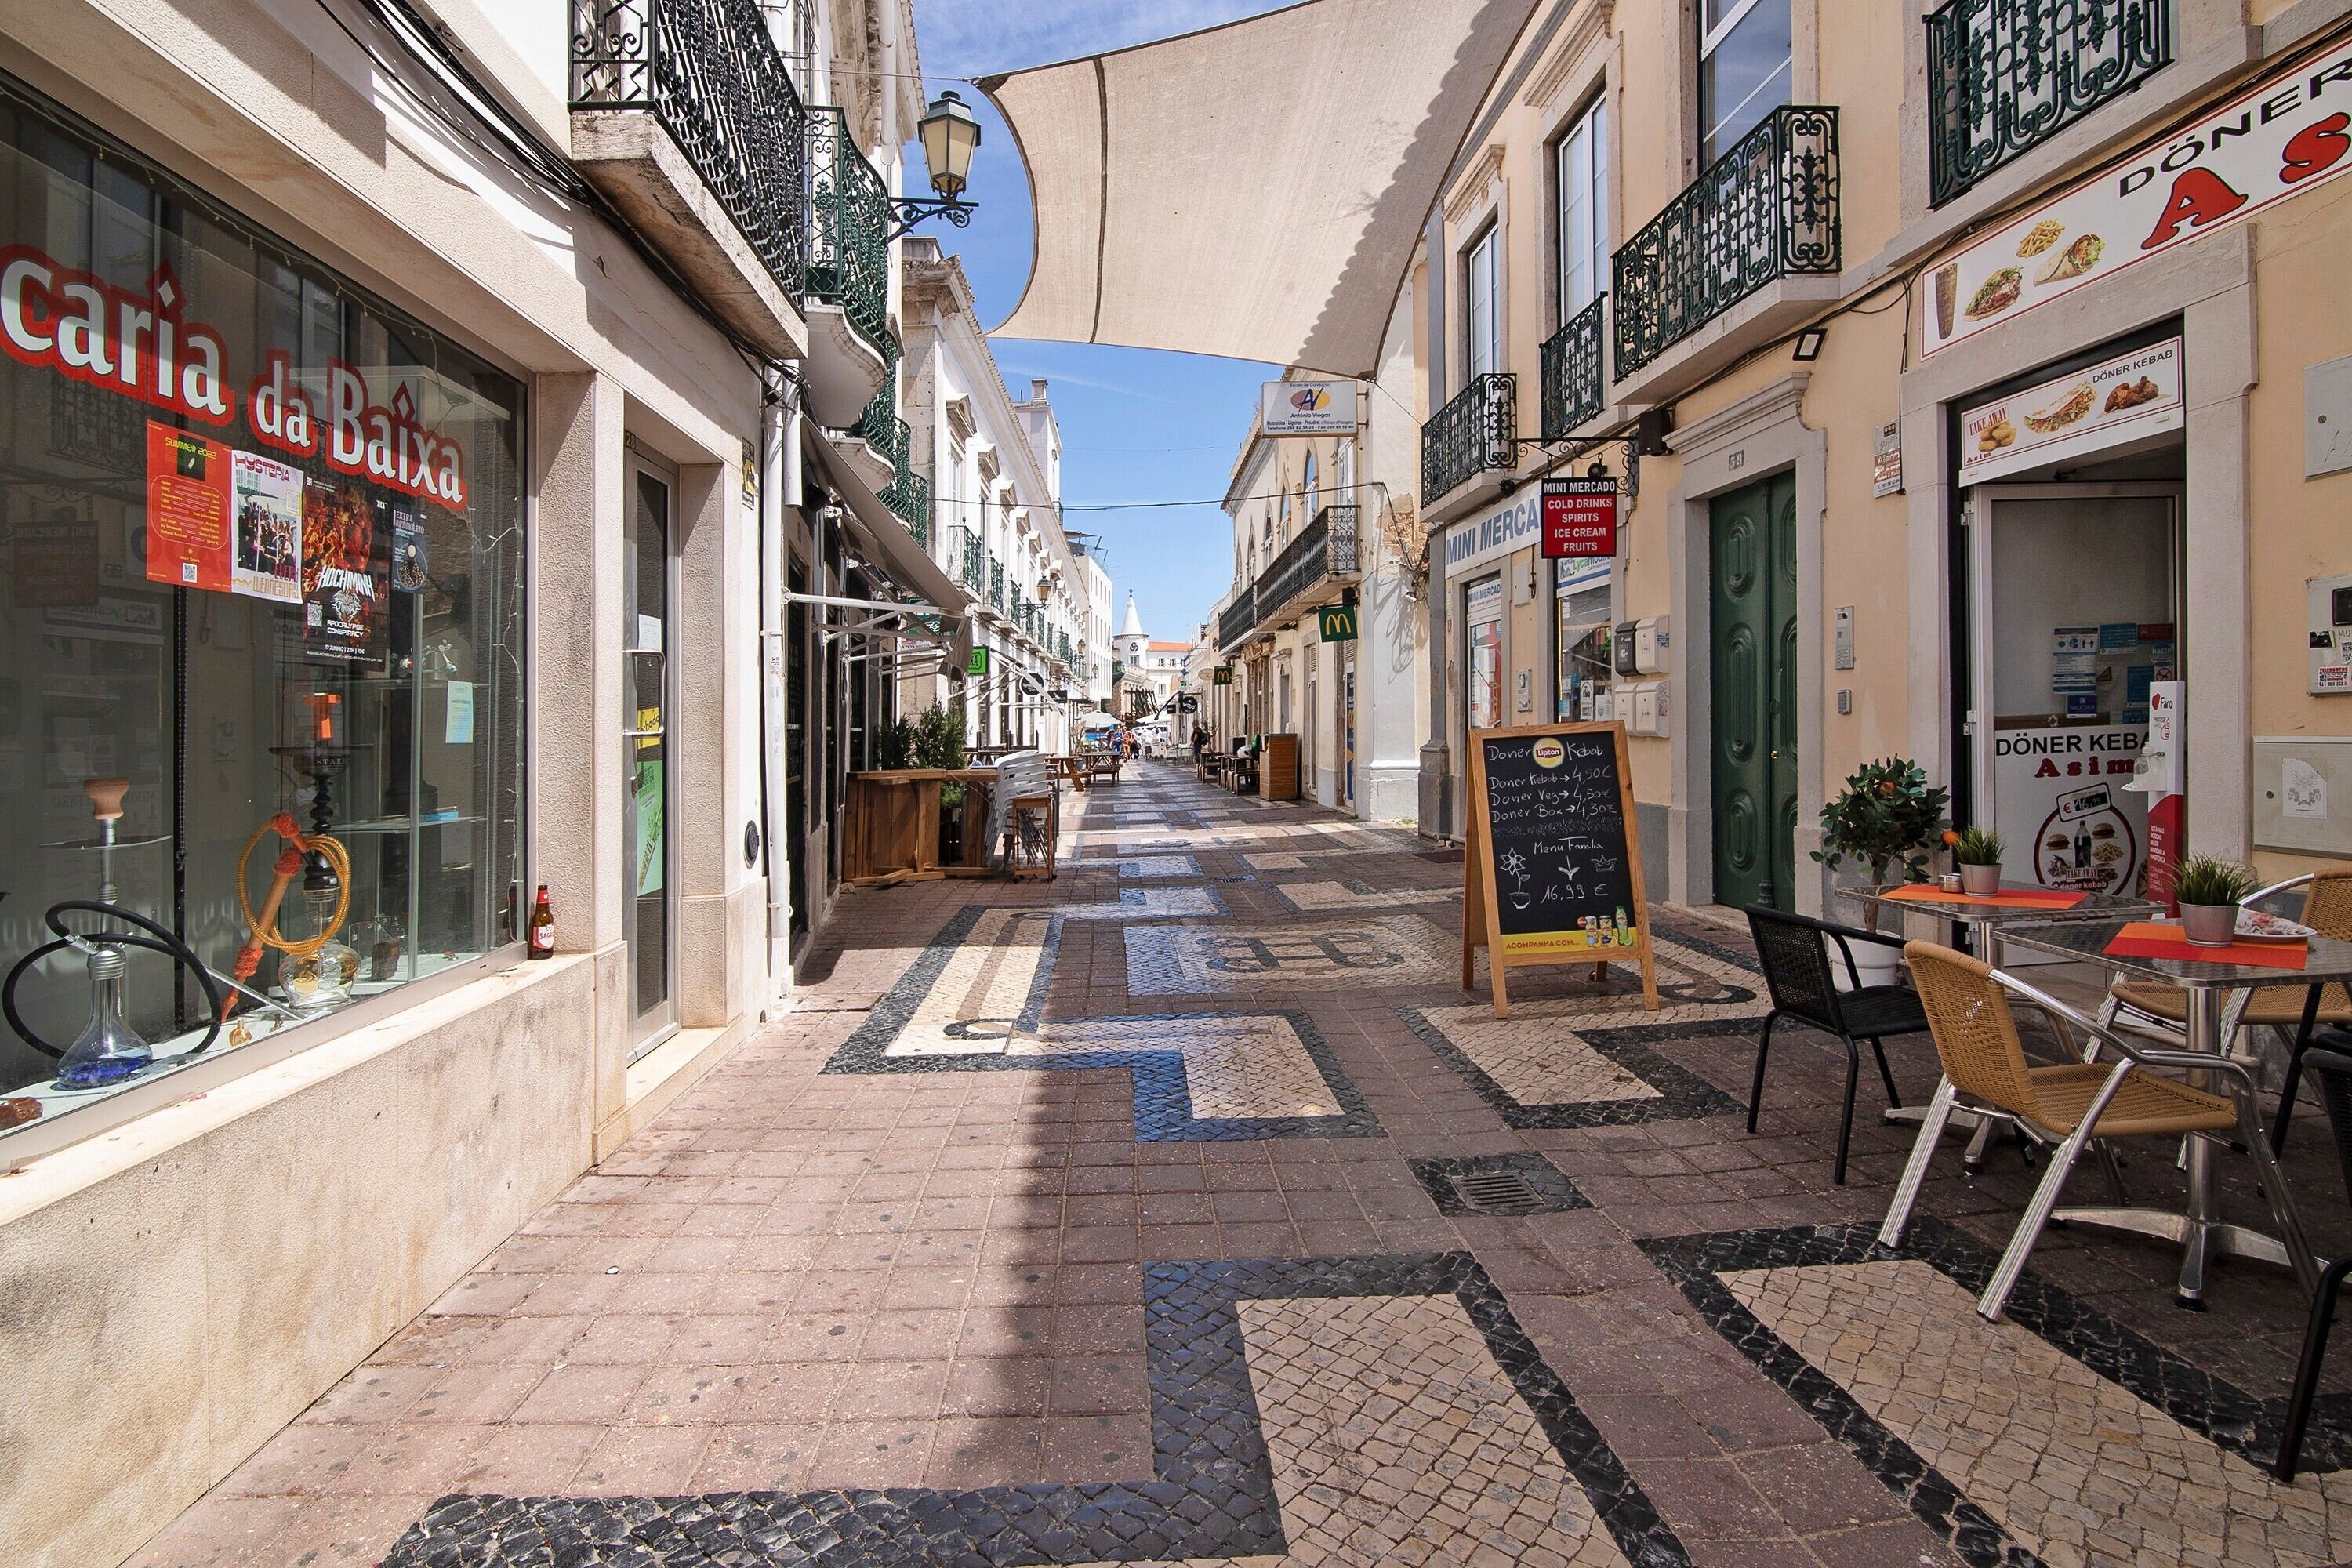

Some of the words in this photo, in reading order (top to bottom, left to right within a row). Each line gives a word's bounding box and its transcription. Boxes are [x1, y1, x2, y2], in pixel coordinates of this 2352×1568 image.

[2119, 60, 2352, 198] DÖNER
[2092, 365, 2130, 384] DÖNER
[2133, 349, 2173, 371] KEBAB
[0, 260, 227, 416] caria
[255, 361, 311, 448] da
[331, 366, 463, 503] Baixa
[1969, 416, 1987, 436] TAKE
[1988, 406, 2008, 427] AWAY
[165, 437, 196, 453] SUMMER
[198, 447, 217, 459] 2022
[234, 454, 290, 483] HYSTERIA
[1544, 483, 1567, 493] MINI
[1570, 481, 1615, 492] MERCADO
[1548, 500, 1573, 509] COLD
[1577, 499, 1612, 508] DRINKS
[397, 510, 413, 522] EXTRA
[1562, 513, 1599, 522] SPIRITS
[1446, 527, 1475, 565] MINI
[1480, 495, 1541, 551] MERCA
[1555, 529, 1570, 538] ICE
[1573, 528, 1606, 537] CREAM
[1563, 542, 1597, 551] FRUITS
[315, 565, 376, 602] HOCHIMINH
[1468, 591, 1479, 602] MINI
[327, 620, 364, 630] APOCALYPSE
[327, 627, 364, 637] CONSPIRACY
[2161, 696, 2173, 710] Faro
[1996, 733, 2082, 756] DÖNER
[1487, 746, 1532, 760] Doner
[2034, 756, 2135, 778] Asim
[1488, 776, 1526, 789] Doner
[1490, 793, 1532, 806] Doner
[1538, 789, 1559, 804] Veg
[1491, 808, 1530, 822] Doner
[1534, 804, 1563, 818] Box
[1534, 841, 1563, 855] Menu
[1594, 884, 1609, 895] €
